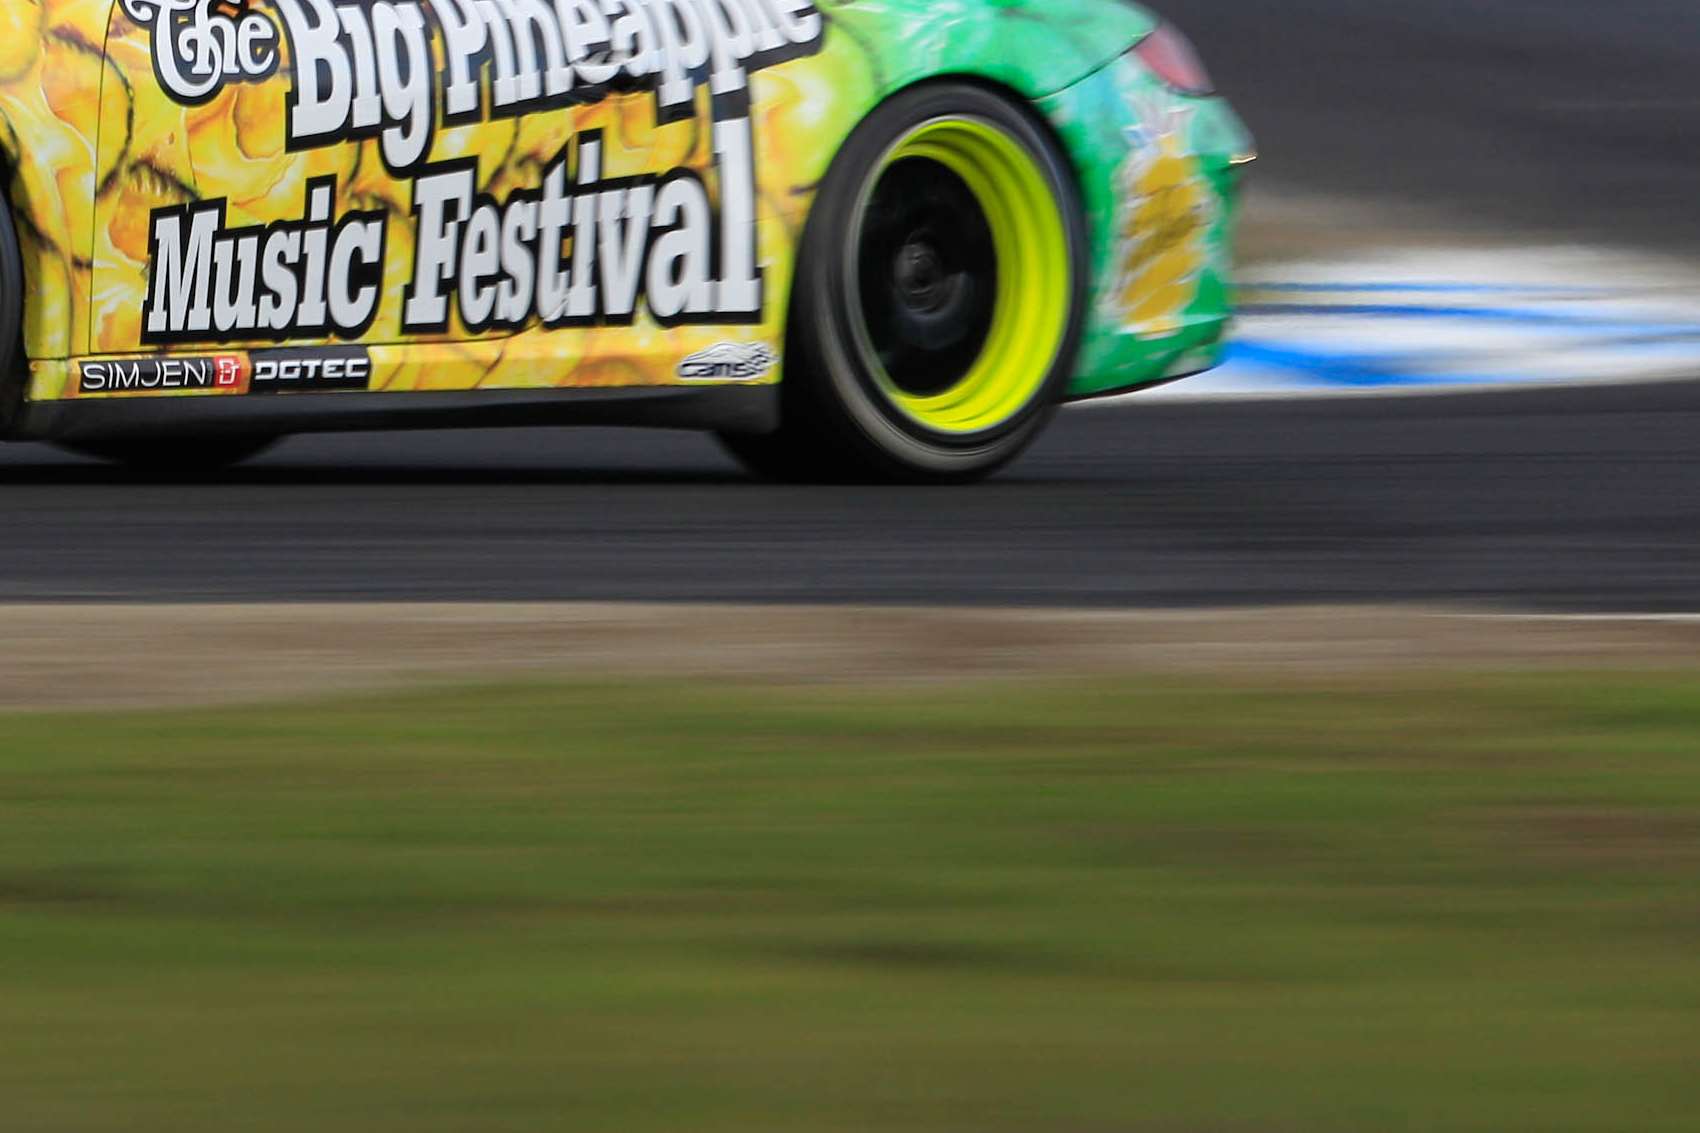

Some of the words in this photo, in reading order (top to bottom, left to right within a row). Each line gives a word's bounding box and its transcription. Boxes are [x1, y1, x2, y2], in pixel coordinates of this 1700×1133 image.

[147, 186, 381, 332] Music
[405, 118, 764, 325] Festival
[82, 358, 206, 390] SIMJEN
